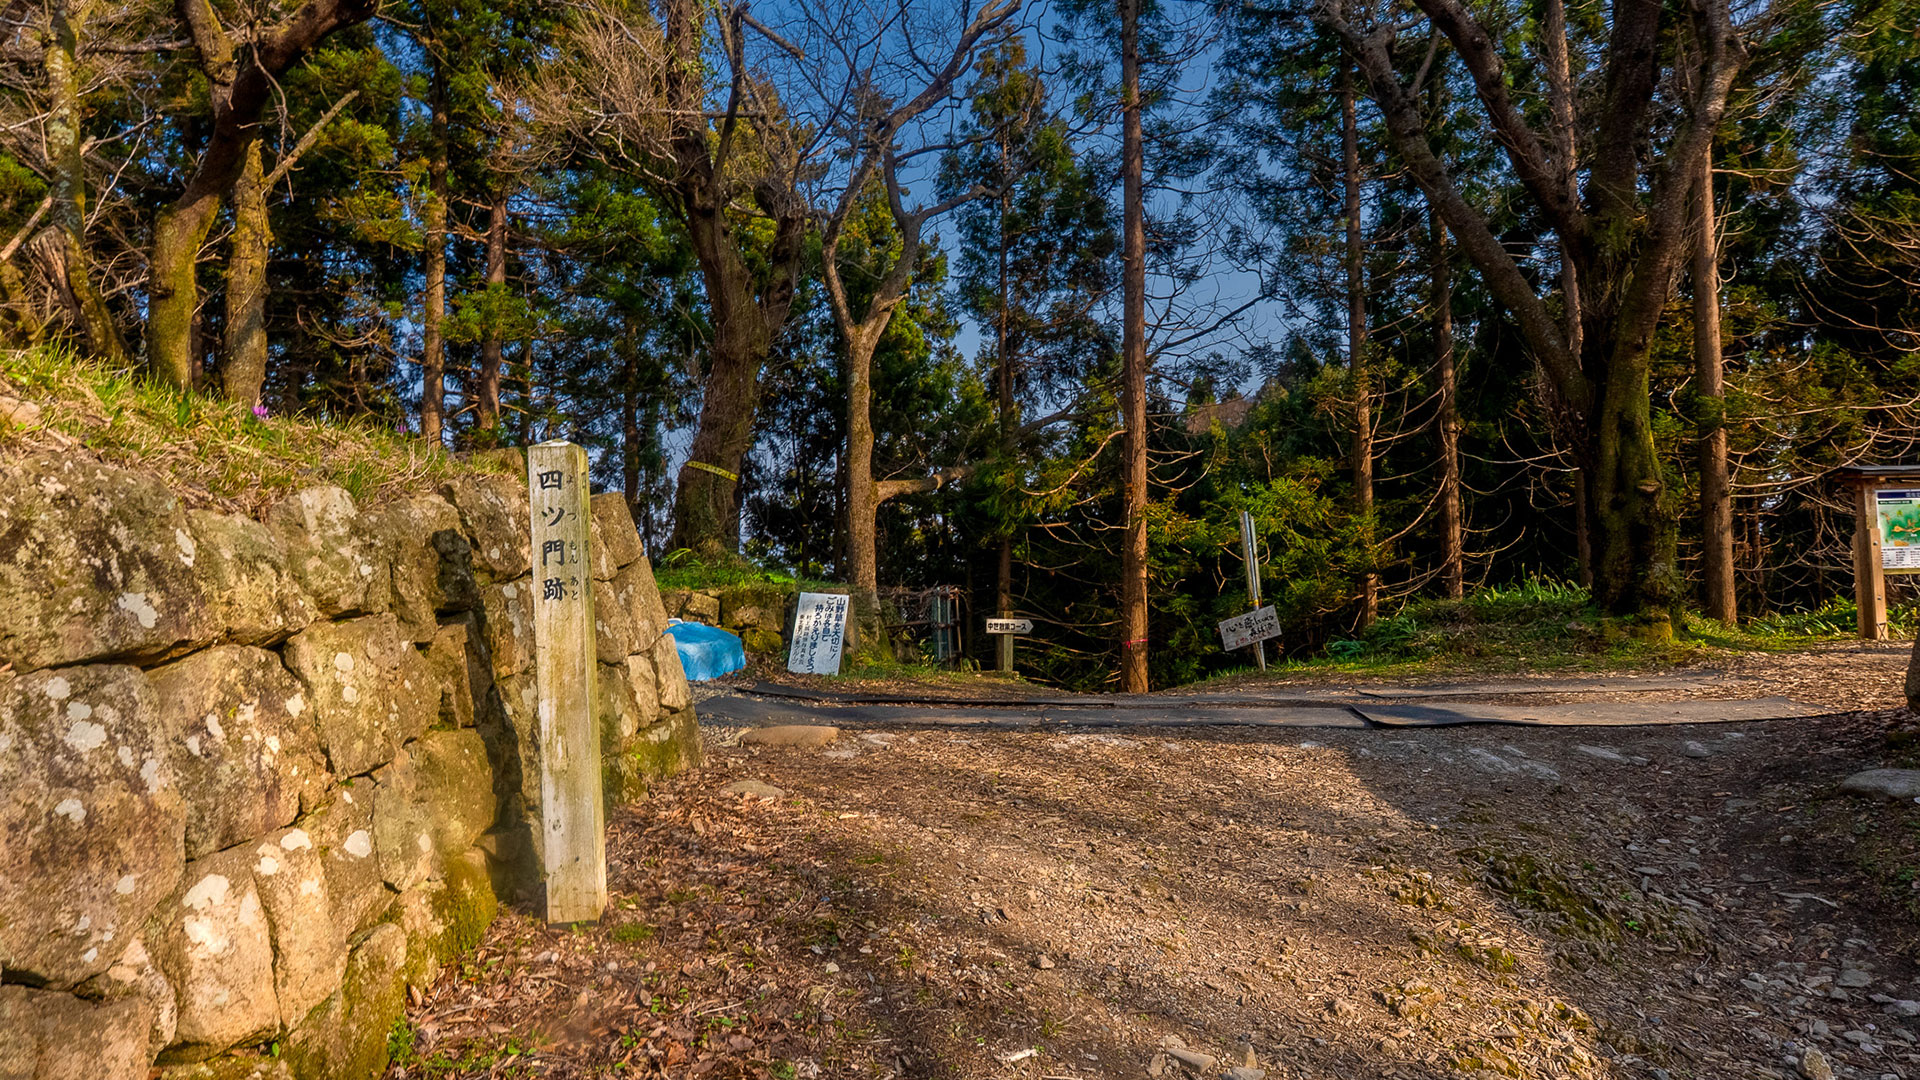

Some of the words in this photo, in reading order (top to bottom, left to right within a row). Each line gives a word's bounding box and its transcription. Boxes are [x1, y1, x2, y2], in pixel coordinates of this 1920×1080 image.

[537, 469, 568, 602] 四ツ門跡
[821, 596, 837, 642] ごみは各自で
